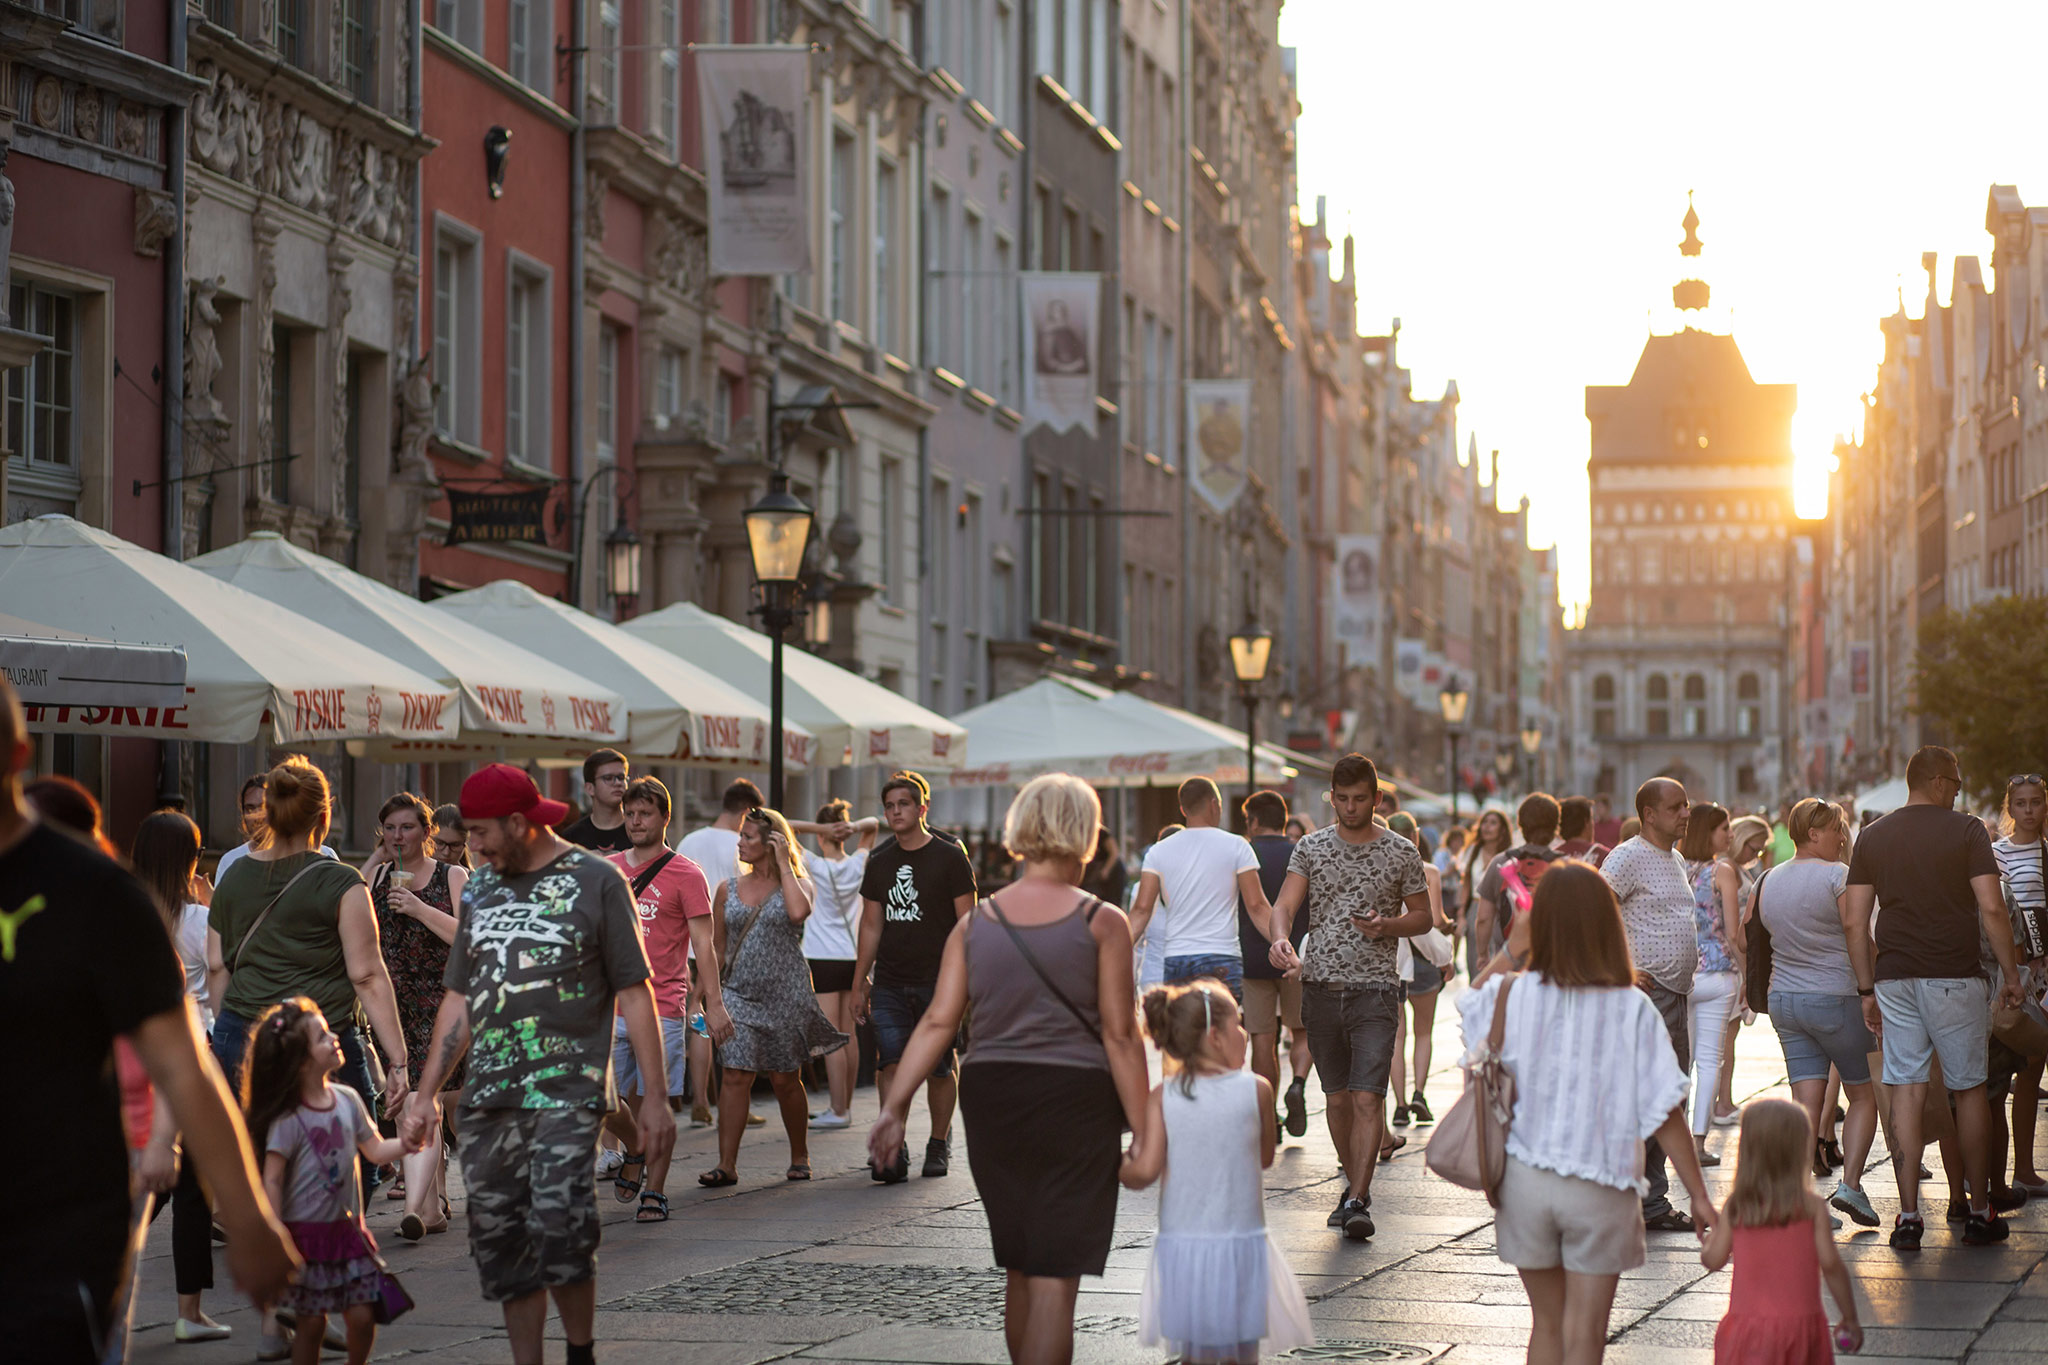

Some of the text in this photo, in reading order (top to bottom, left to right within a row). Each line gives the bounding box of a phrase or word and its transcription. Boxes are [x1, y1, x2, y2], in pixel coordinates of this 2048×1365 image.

[455, 523, 537, 540] AMBER
[293, 688, 346, 731] TYSKIE
[399, 691, 446, 731] TYSKIE
[476, 685, 527, 724] TYSKIE
[568, 695, 616, 735] TYSKIE
[702, 714, 741, 749] TYSKIE
[487, 908, 531, 921] NO
[886, 902, 921, 922] DAKAR
[2028, 912, 2044, 954] adidas
